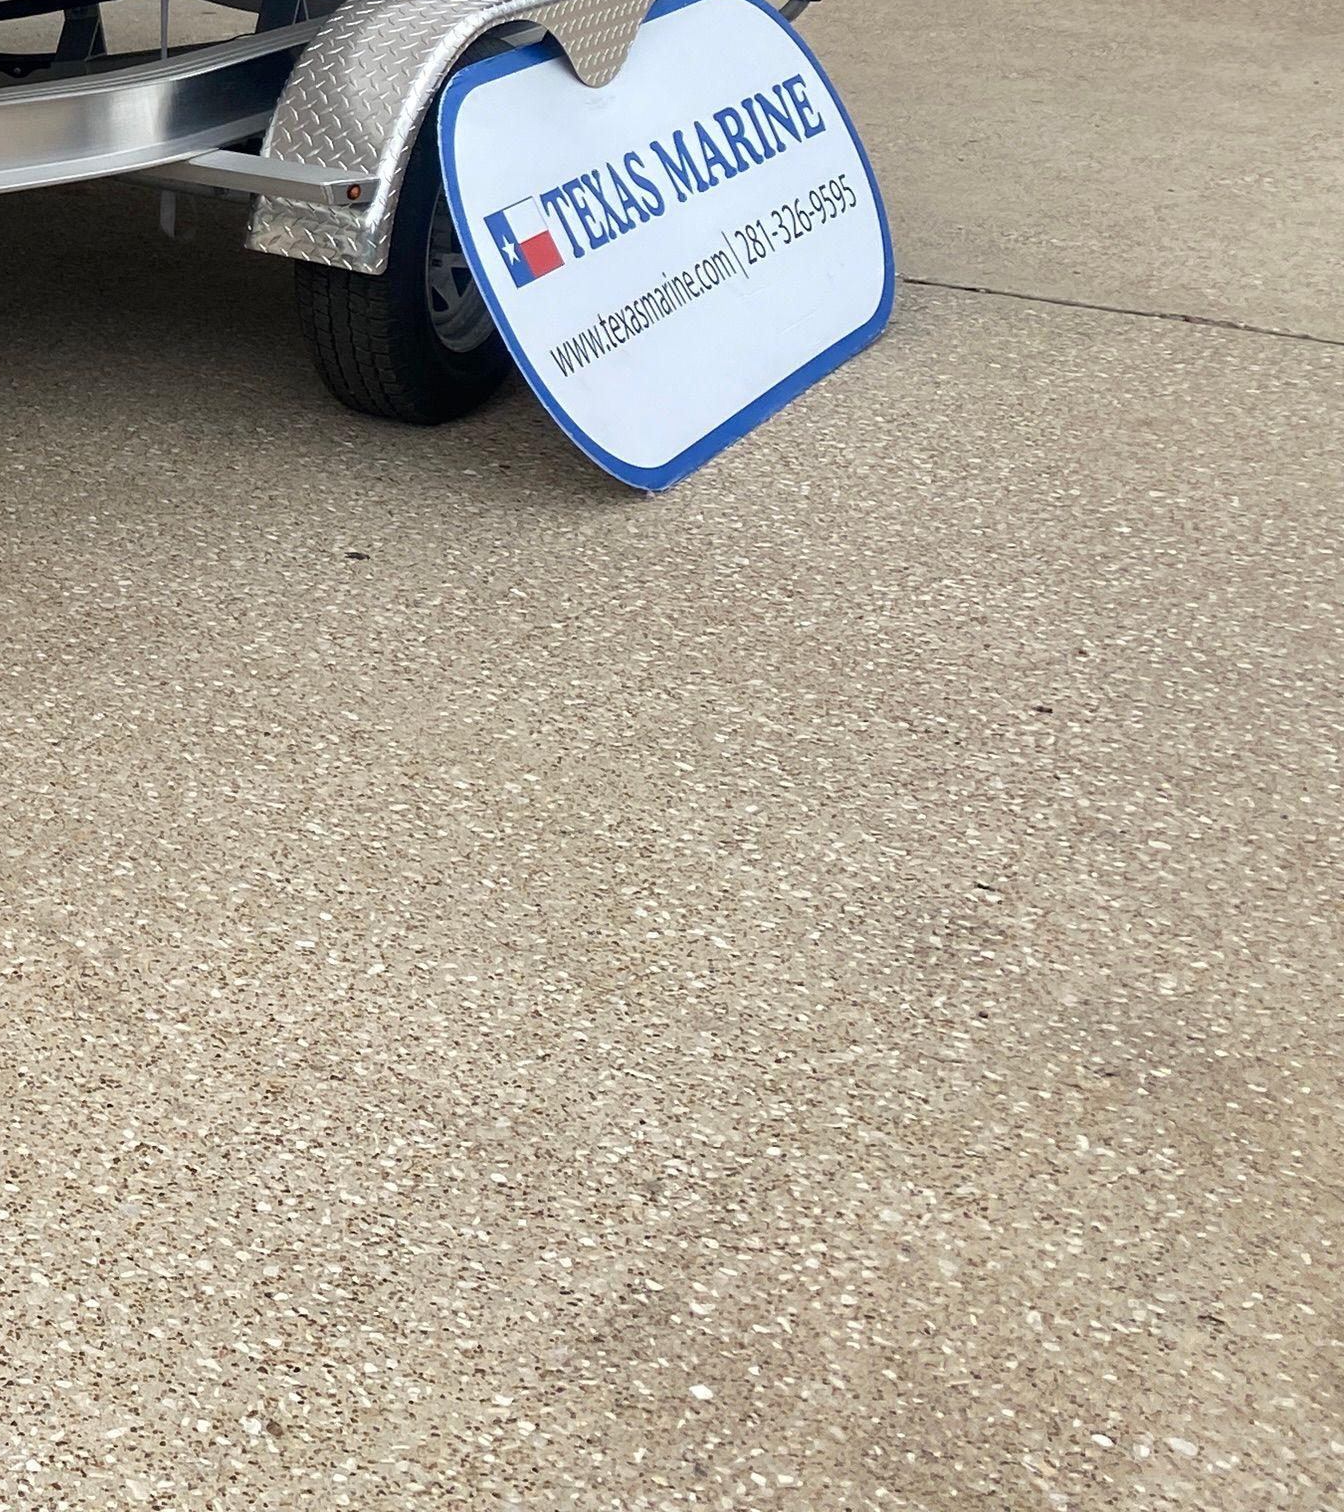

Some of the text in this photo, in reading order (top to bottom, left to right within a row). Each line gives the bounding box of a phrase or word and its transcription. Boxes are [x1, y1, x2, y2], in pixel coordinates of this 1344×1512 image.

[540, 74, 827, 259] TEXAS MARINE
[550, 250, 737, 378] www.texasmarine.com
[734, 174, 857, 264] 281-326-9595
